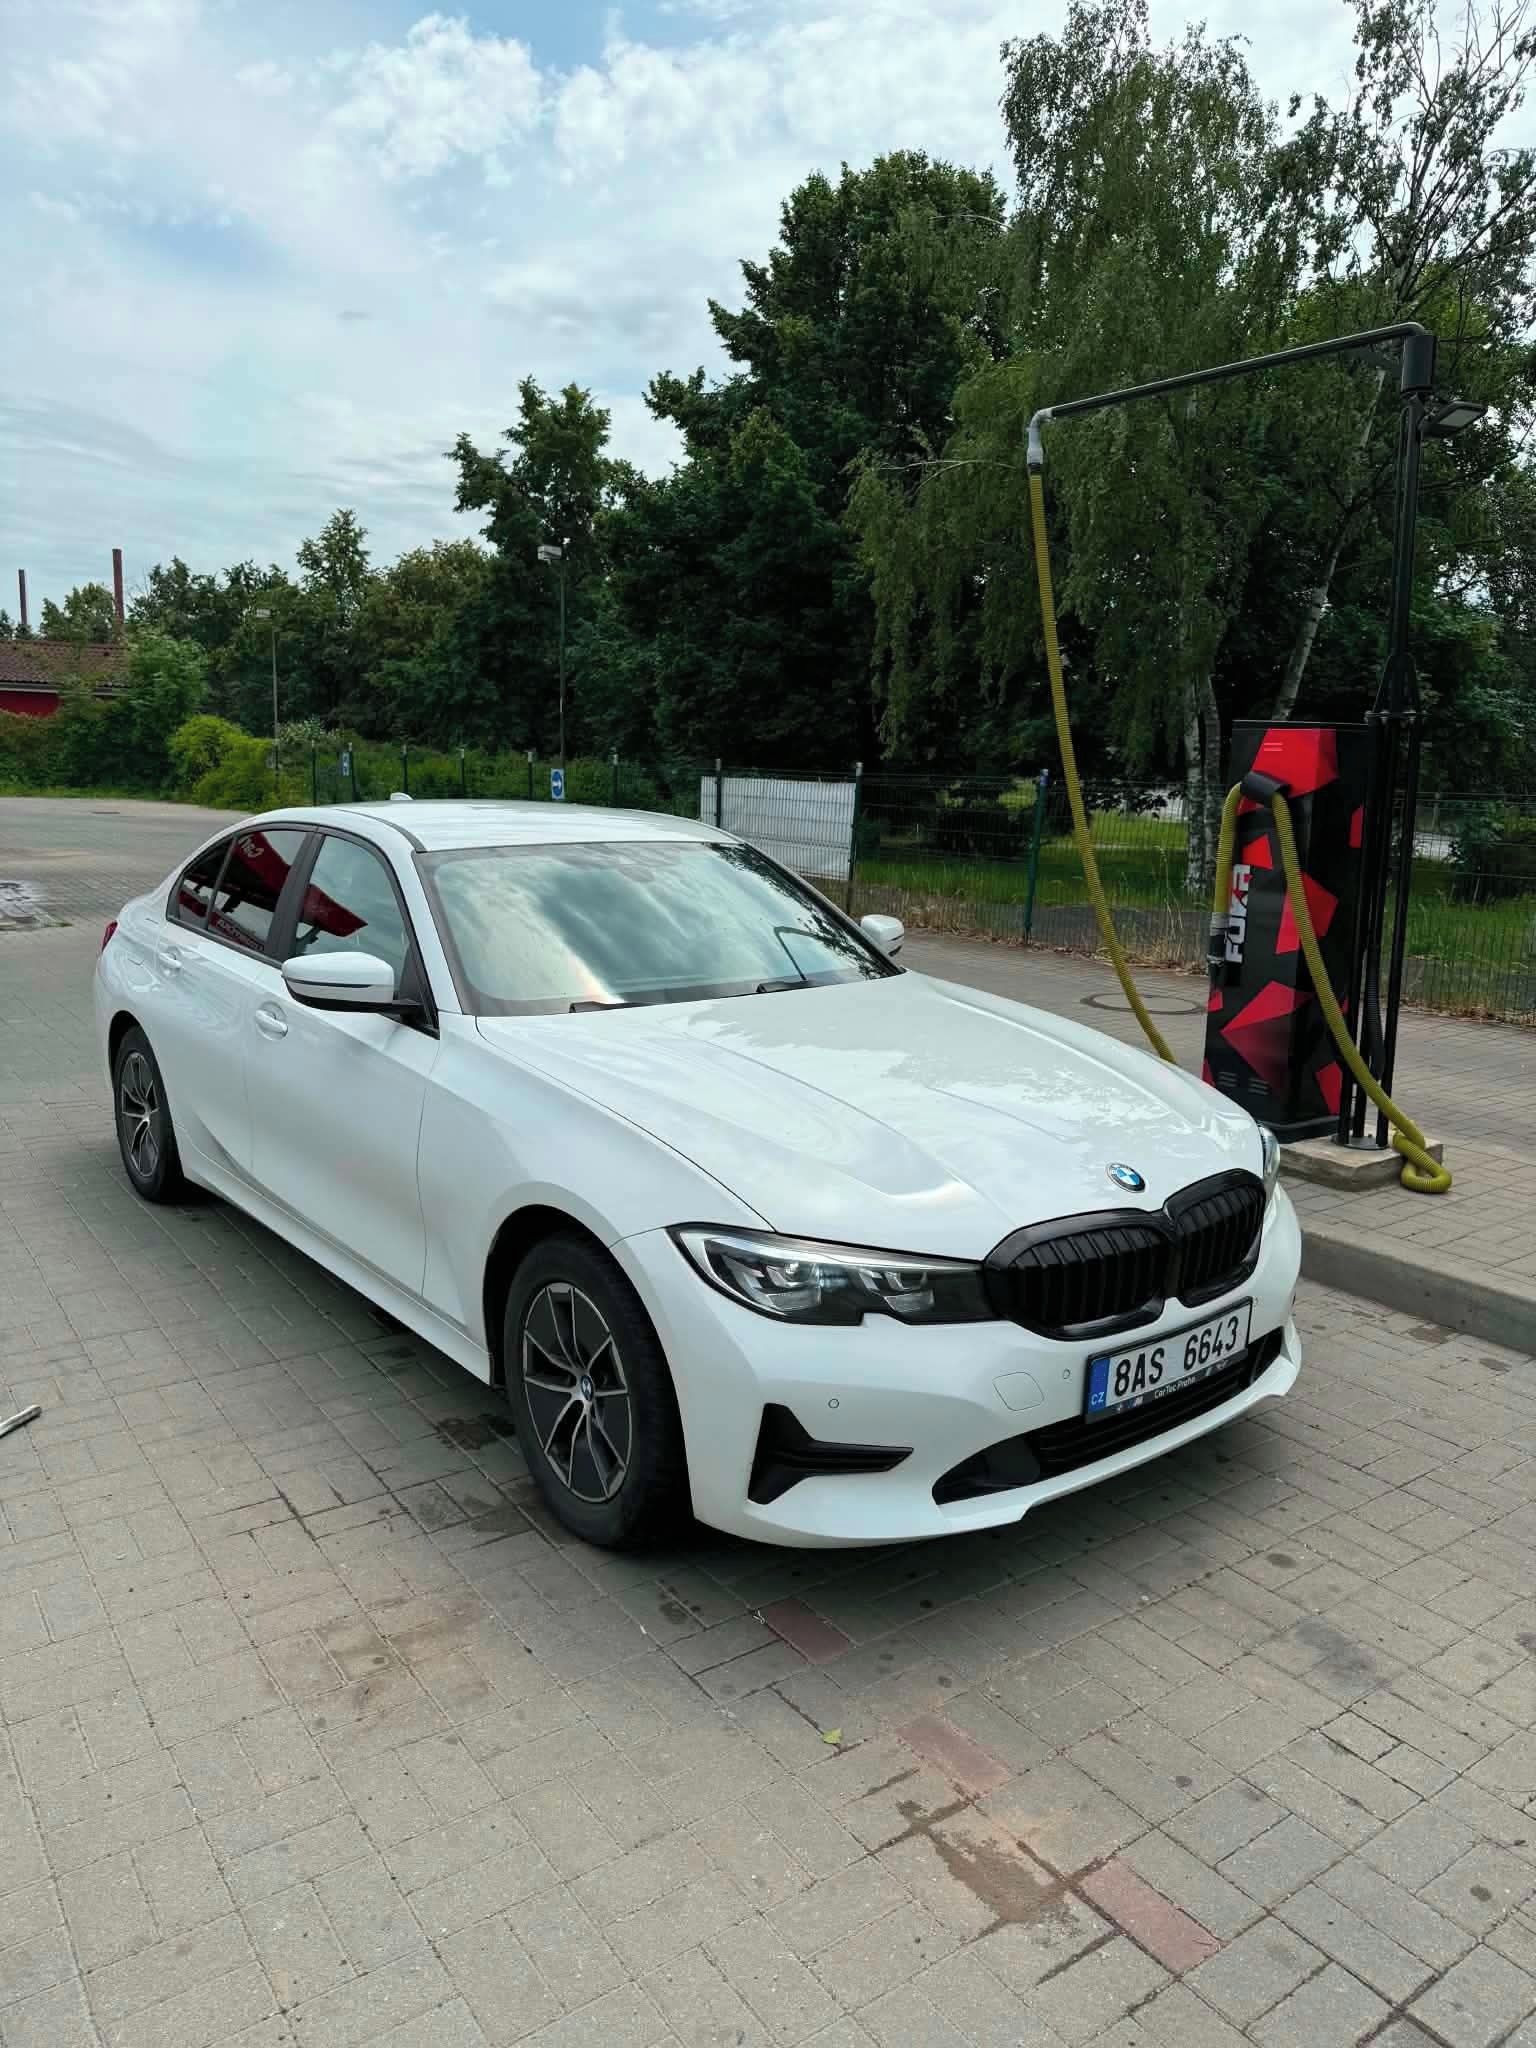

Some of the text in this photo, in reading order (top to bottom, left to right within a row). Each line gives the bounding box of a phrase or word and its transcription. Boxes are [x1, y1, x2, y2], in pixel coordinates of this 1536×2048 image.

[1115, 1316, 1239, 1396] 8AS 6643
[1091, 1391, 1105, 1406] CZ
